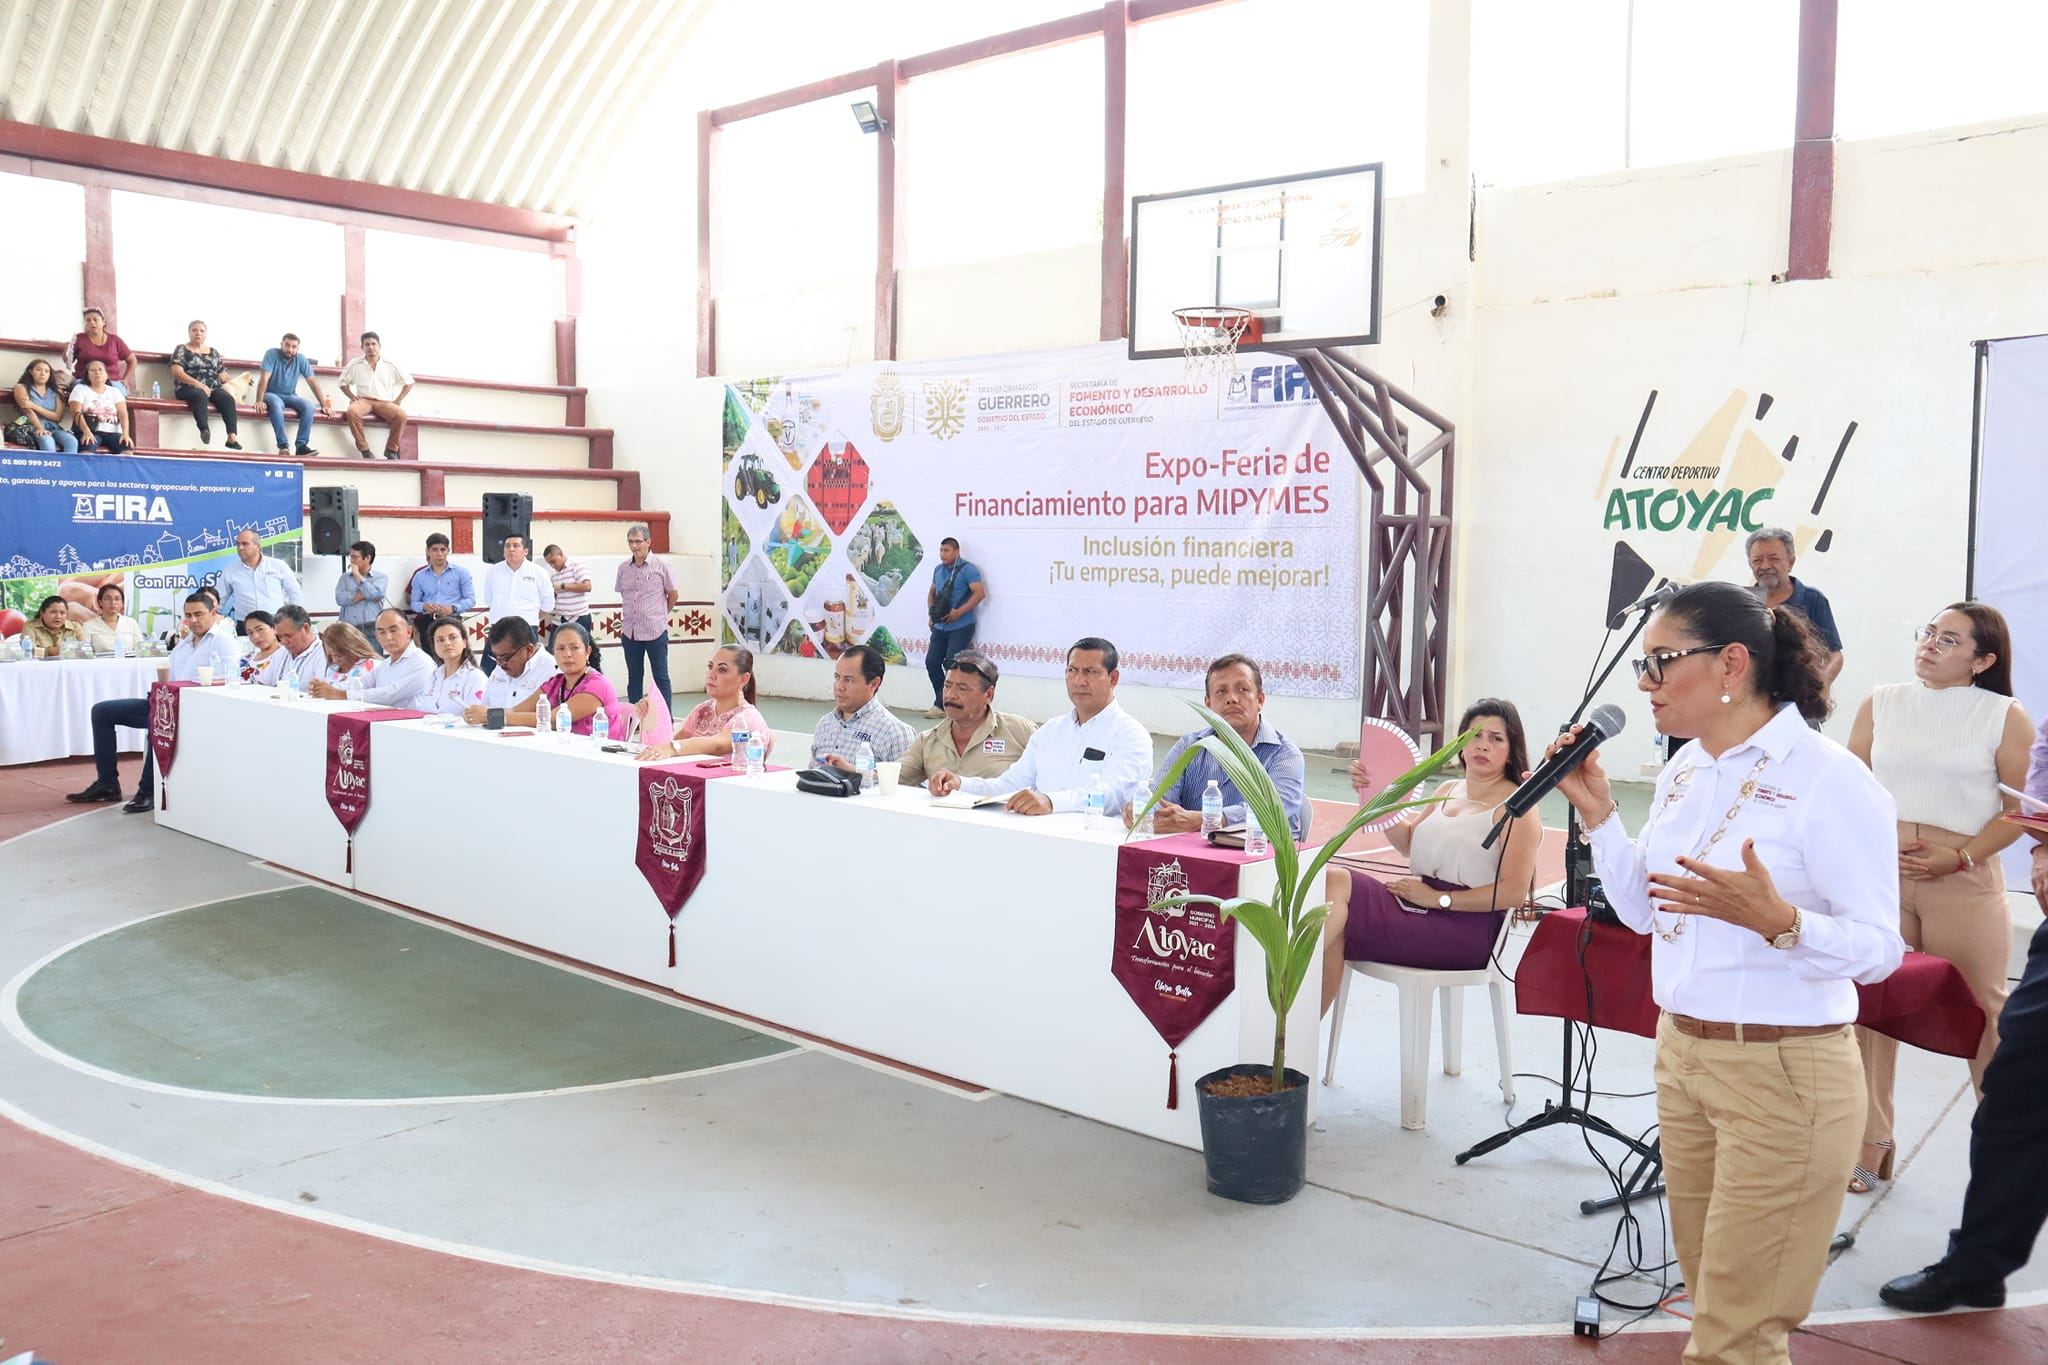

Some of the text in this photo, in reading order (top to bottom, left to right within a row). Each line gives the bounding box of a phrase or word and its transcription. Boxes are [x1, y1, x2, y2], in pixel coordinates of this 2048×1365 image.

[1109, 378, 1118, 386] DE
[1250, 364, 1334, 403] FIR
[1069, 383, 1208, 402] FOMENTO Y DESARROLLO
[978, 393, 1051, 411] GUERRERO
[1069, 402, 1133, 417] ECONÓMICO
[1021, 413, 1046, 421] ESTADO
[1069, 416, 1154, 427] DEL ESTADO DE GUERRERO
[1145, 442, 1331, 486] Expo-Feria de
[1632, 466, 1721, 480] CENTRO DEPORTIVO
[11, 477, 50, 486] garantías
[59, 480, 87, 488] apoyos
[106, 480, 117, 488] los
[118, 481, 149, 489] sectores
[150, 483, 199, 492] agropecuario,
[199, 485, 231, 493] pesquero
[95, 495, 173, 521] FIRA
[955, 485, 1330, 523] Financiamiento para MIPYMES
[1603, 487, 1775, 533] ATOYAC
[1082, 534, 1294, 559] Inclusión financiera
[134, 574, 162, 588] Con
[164, 575, 198, 588] FIRA
[1049, 560, 1330, 592] ¡Tu empresa, puede mejorar!
[1190, 915, 1215, 924] MUNICIPAL
[1132, 916, 1216, 961] Atoyac
[1171, 963, 1185, 972] para
